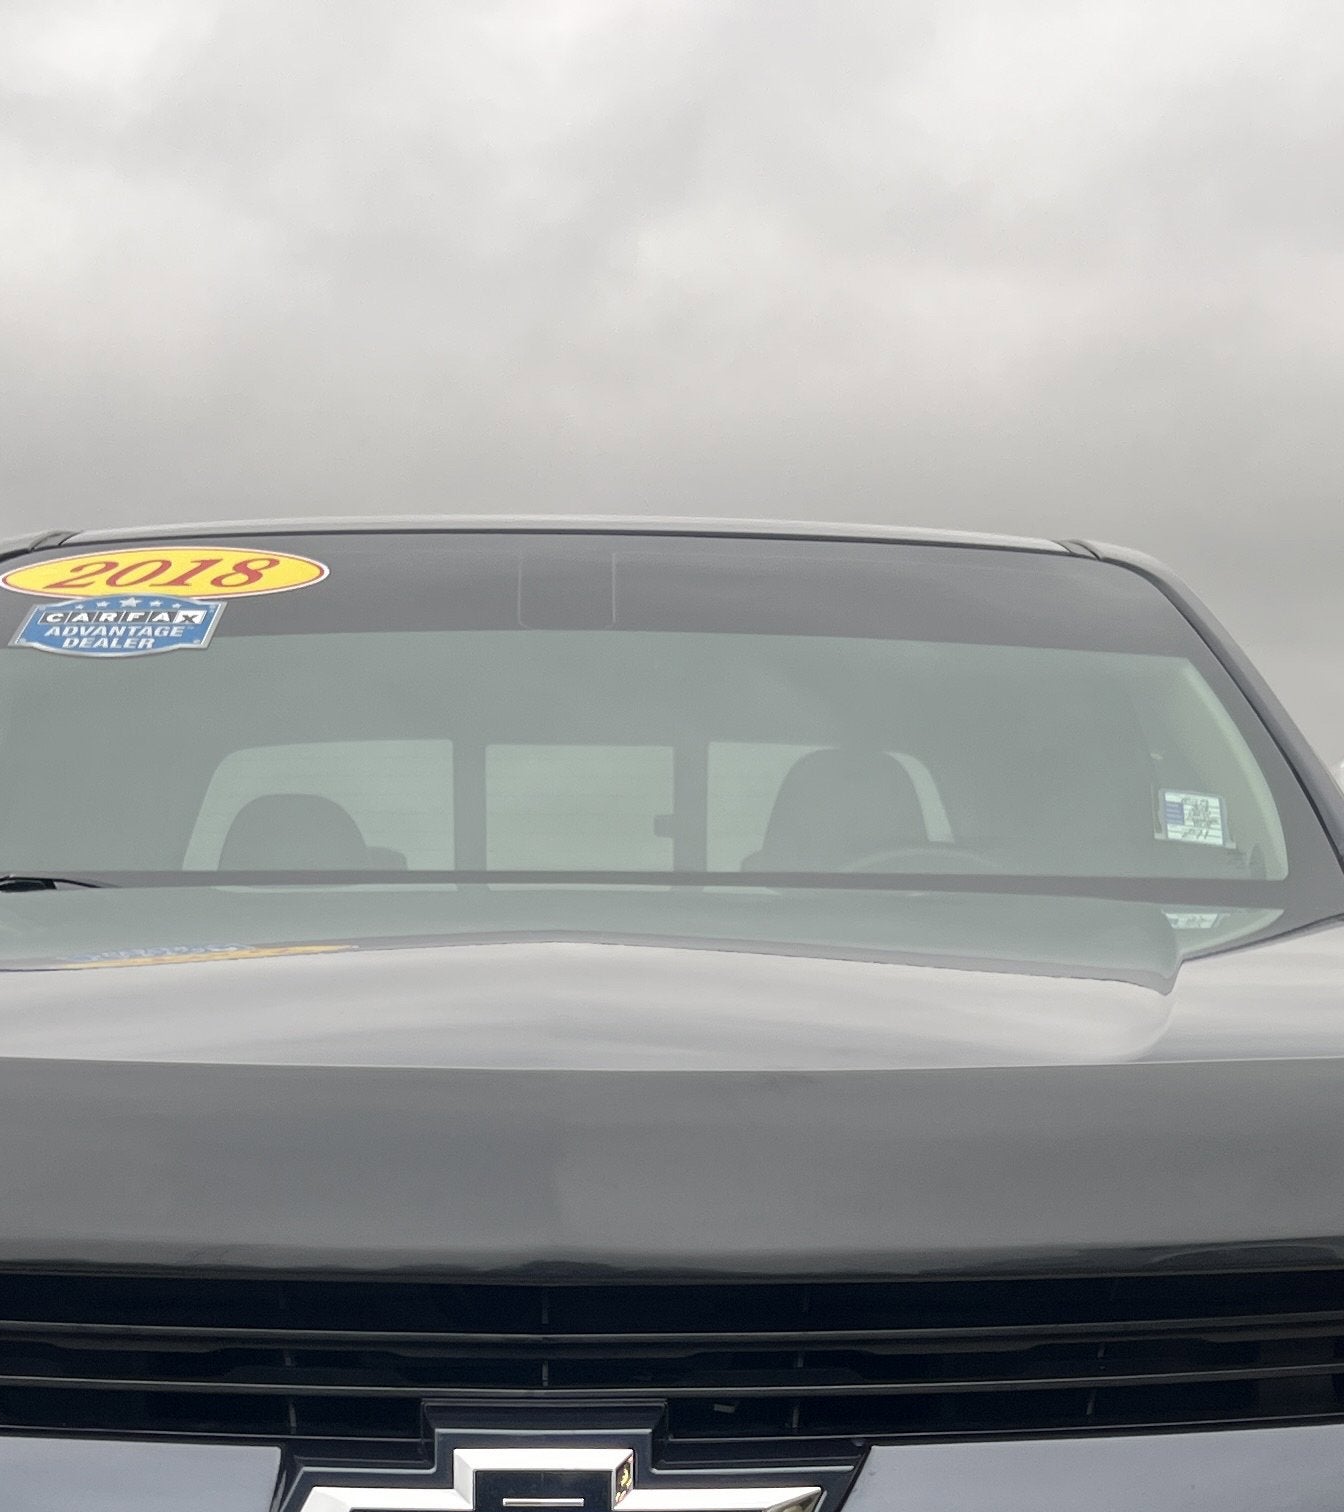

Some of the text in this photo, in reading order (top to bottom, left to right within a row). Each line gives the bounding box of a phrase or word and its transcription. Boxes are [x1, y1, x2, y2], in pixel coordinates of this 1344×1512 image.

[42, 557, 281, 589] 2018
[44, 611, 201, 624] CARFAX
[44, 625, 186, 638] ADVANTAGE
[62, 637, 156, 649] DEALER
